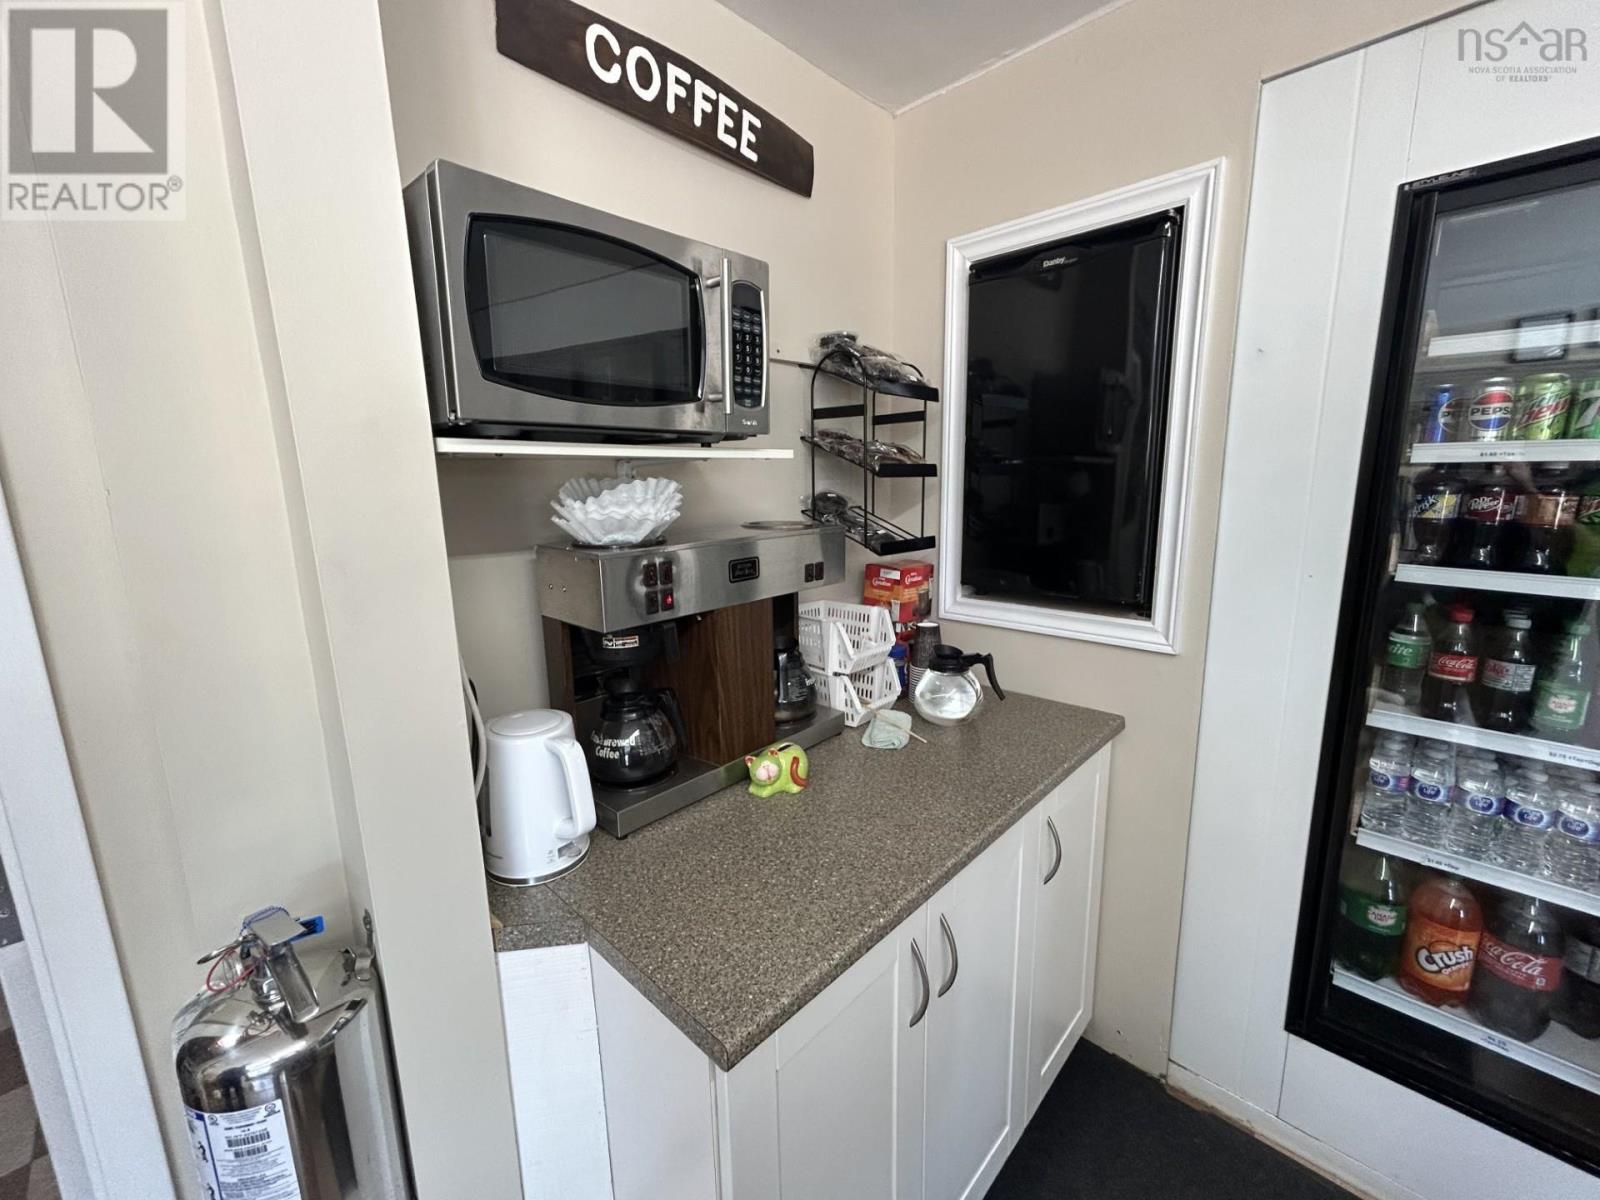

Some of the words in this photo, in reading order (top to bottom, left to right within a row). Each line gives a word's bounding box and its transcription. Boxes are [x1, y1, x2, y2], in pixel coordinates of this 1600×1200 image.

[585, 23, 762, 162] COFFEE
[595, 745, 620, 759] Coffee
[1417, 946, 1474, 973] Crush
